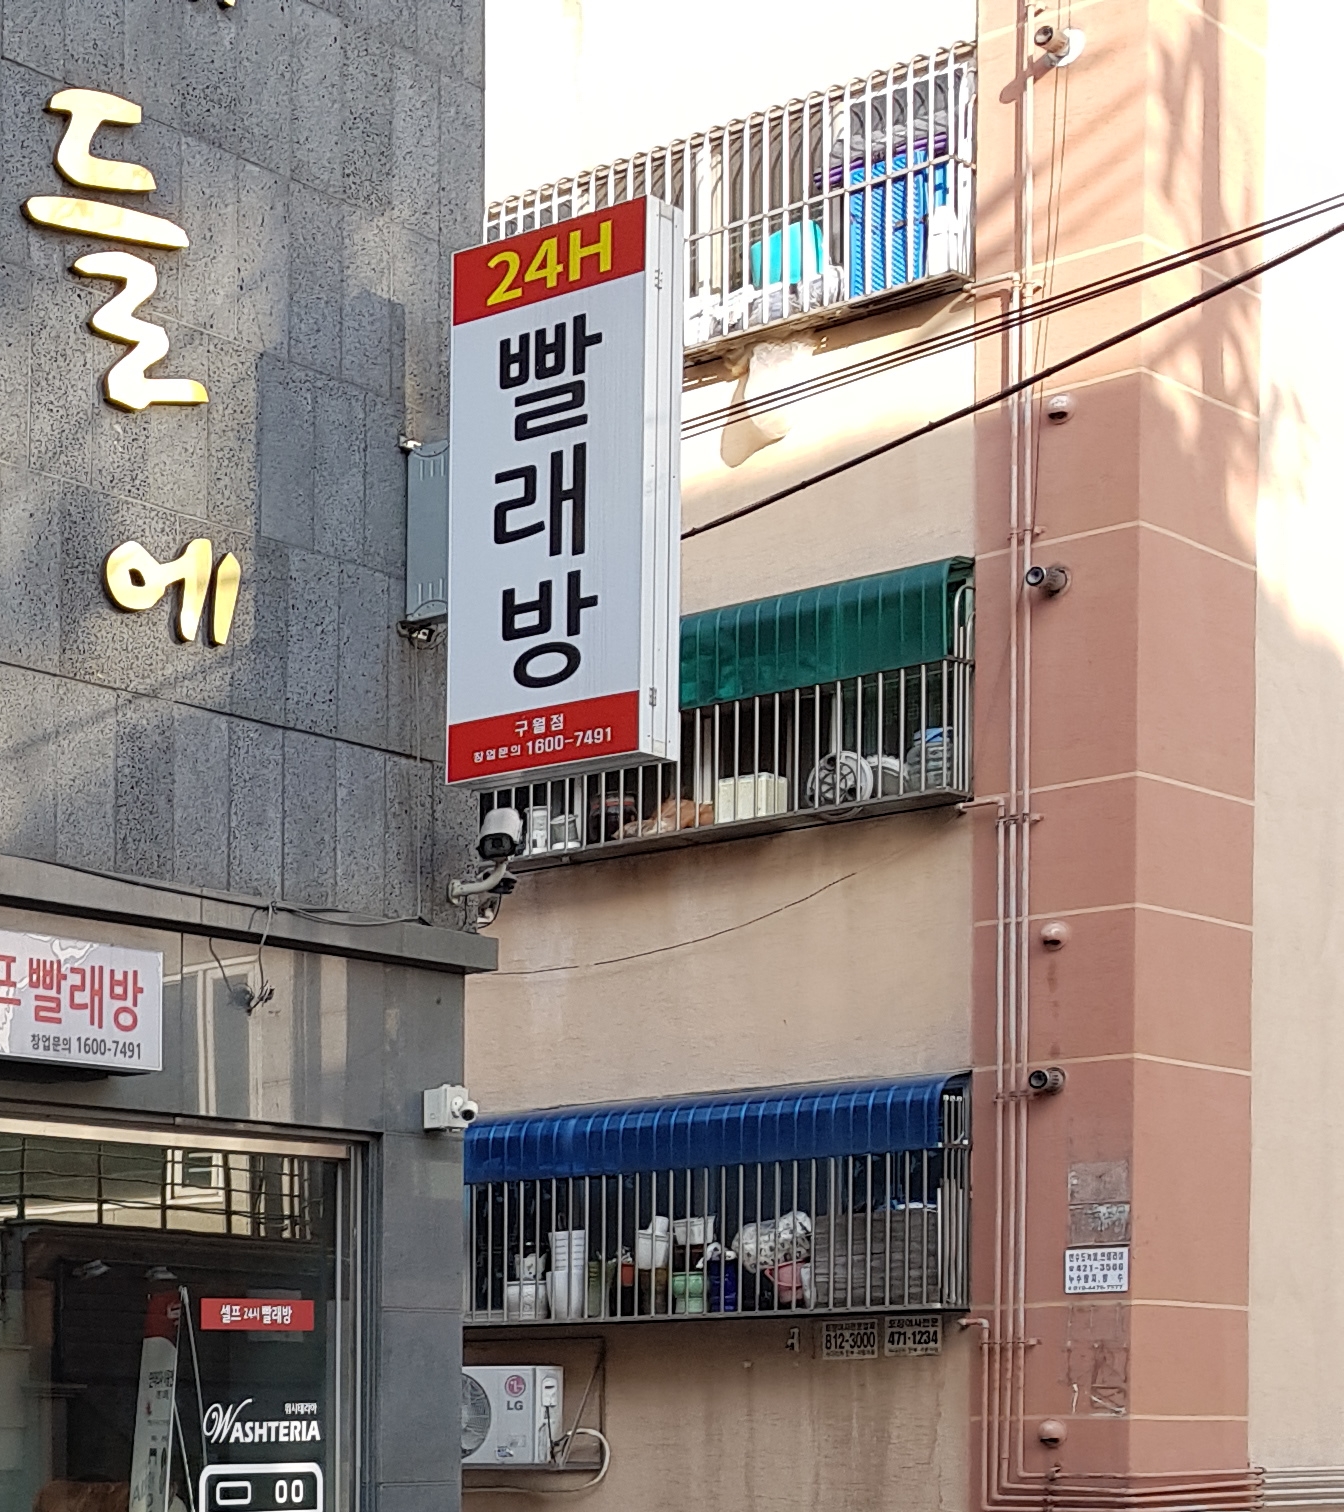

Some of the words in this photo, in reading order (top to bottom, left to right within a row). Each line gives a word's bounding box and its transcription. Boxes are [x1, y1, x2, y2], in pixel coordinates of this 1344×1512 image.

[486, 220, 613, 307] 24H
[493, 312, 603, 689] 빨래방
[526, 726, 612, 756] 1600-7491
[30, 1033, 72, 1054] 창업문의
[76, 1036, 142, 1060] 1600-7491
[220, 1304, 242, 1324] 셀프
[261, 1305, 292, 1325] 빨래방
[825, 1331, 876, 1350] 812-3000
[506, 1400, 524, 1411] LG
[202, 1398, 321, 1444] WASHTERIA
